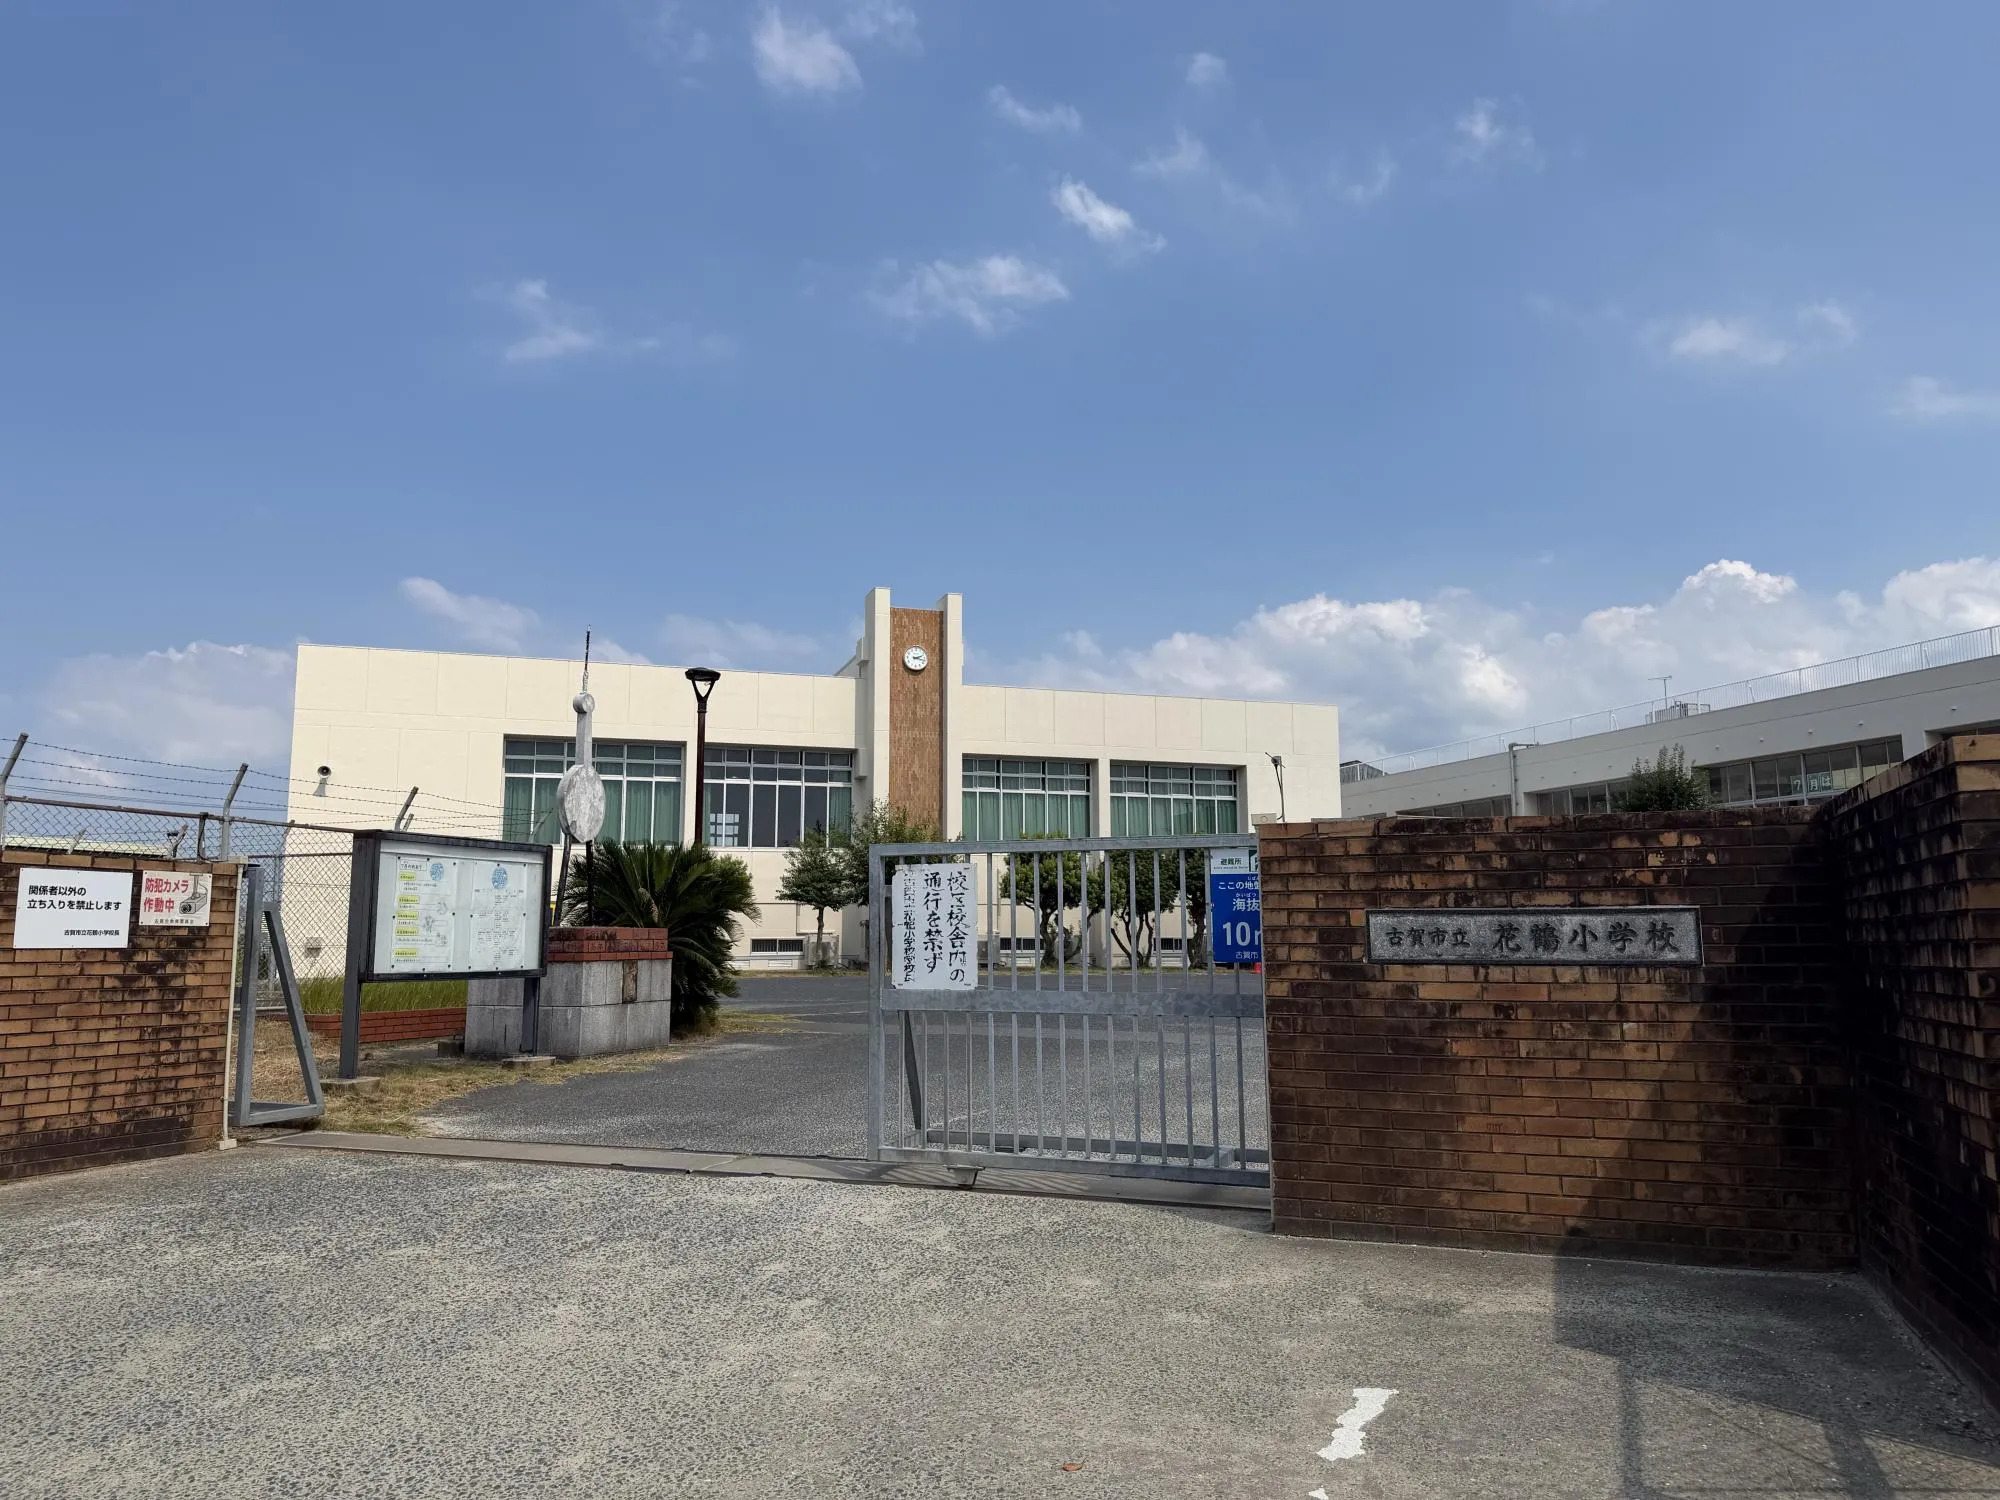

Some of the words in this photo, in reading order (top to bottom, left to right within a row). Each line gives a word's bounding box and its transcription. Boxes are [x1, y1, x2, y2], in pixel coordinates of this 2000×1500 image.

[1220, 857, 1242, 866] 避難所
[28, 884, 87, 897] 関係者以外の
[145, 877, 190, 893] 防犯カメラ
[26, 899, 122, 911] 立ち入りを禁止します
[143, 897, 175, 913] 作動中
[1232, 898, 1260, 912] 海抜
[922, 871, 945, 974] 通行を禁ず
[1384, 926, 1472, 948] 古賀市立
[1492, 920, 1679, 952] 花鶴小学校
[1235, 951, 1259, 960] 古賀市
